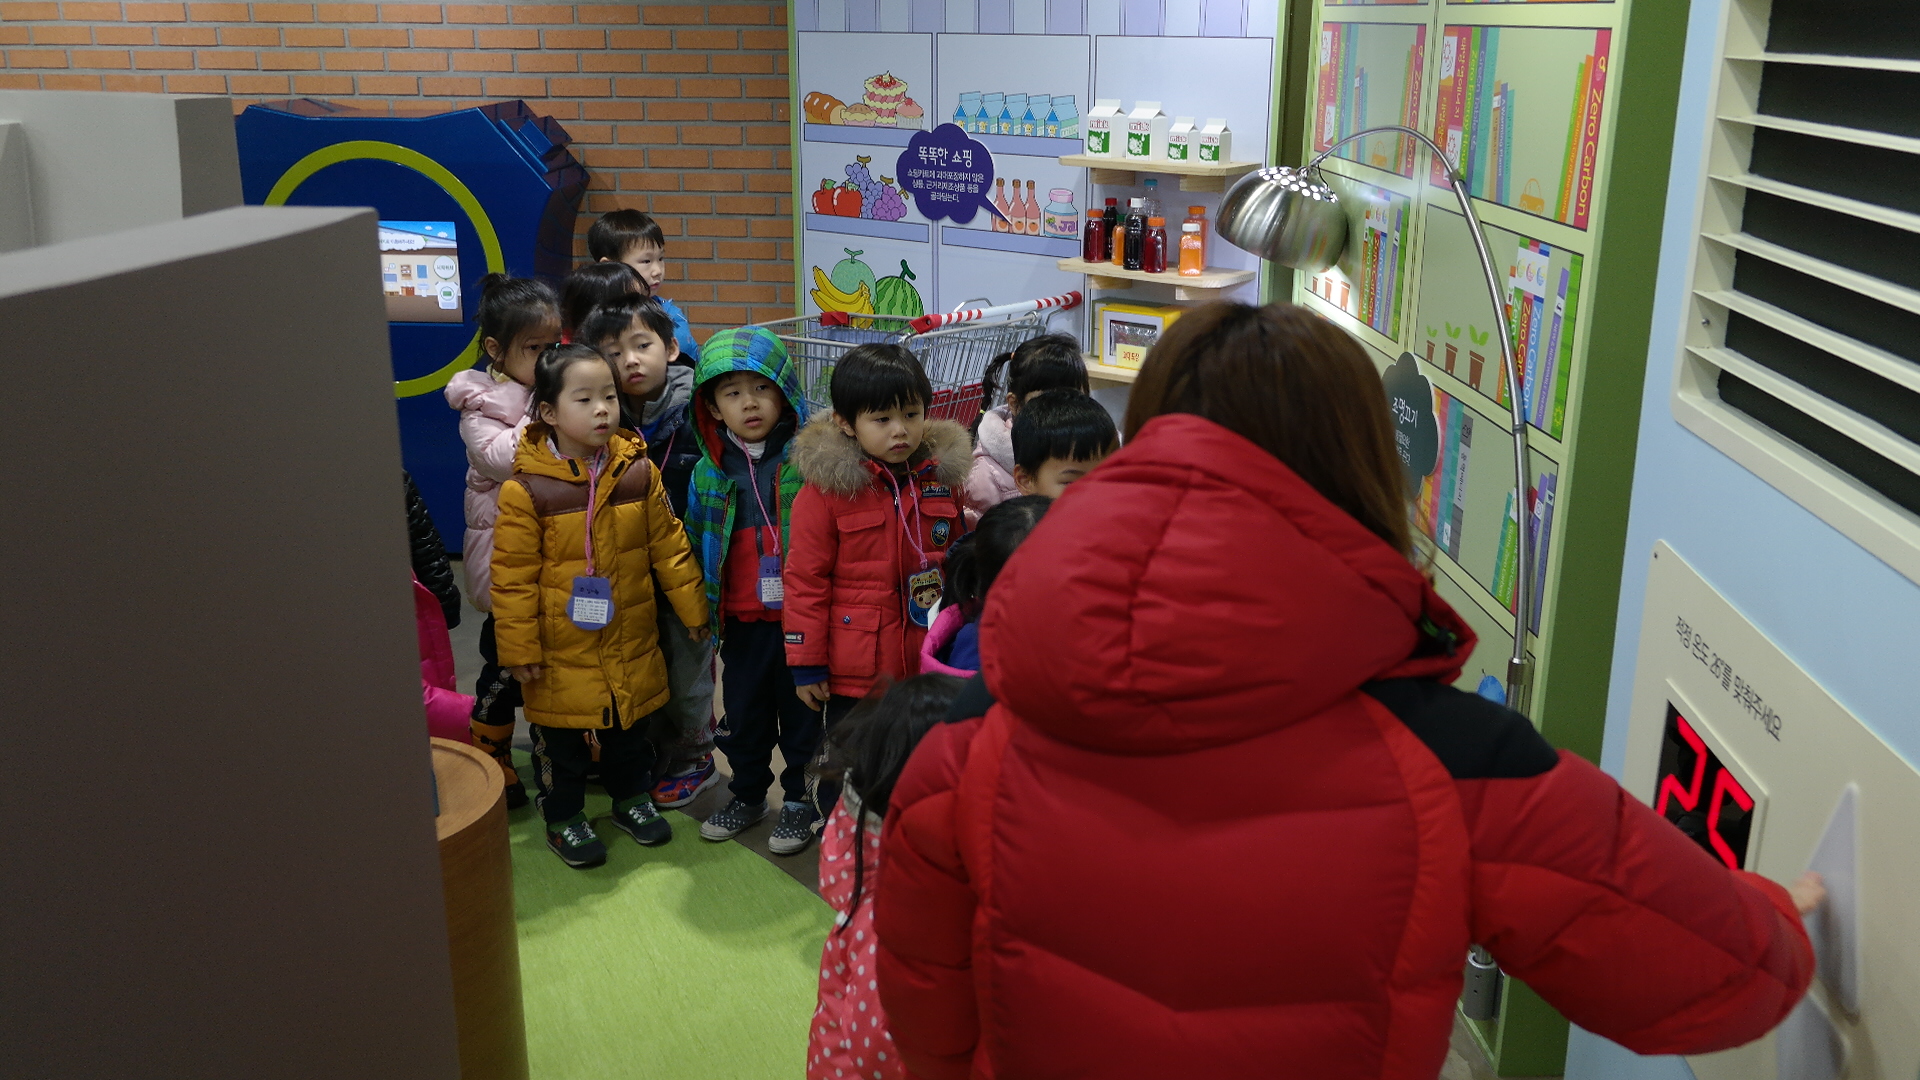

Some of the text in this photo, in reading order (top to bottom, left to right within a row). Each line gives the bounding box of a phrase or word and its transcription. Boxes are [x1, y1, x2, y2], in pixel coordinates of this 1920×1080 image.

[1454, 37, 1466, 118] 태양열에너지
[1476, 51, 1484, 92] Green
[1090, 120, 1108, 128] milk
[1129, 121, 1150, 131] milk
[1406, 70, 1422, 168] Zero Cabon
[1434, 98, 1446, 174] 태양광에지
[1460, 50, 1478, 175] Zero Energy House
[918, 146, 972, 168] 똑똑한 쇼핑
[1578, 88, 1602, 216] Zero Carbon
[1362, 267, 1370, 314] Carbon
[1368, 237, 1380, 318] Zero Carbon
[1374, 274, 1382, 320] Carbon
[1512, 298, 1520, 336] Zero
[1517, 302, 1530, 376] Zero Car
[1524, 306, 1541, 408] Zero Carbon
[1392, 397, 1418, 428] 조명끄기
[1676, 616, 1782, 742] 적정 온도 26°를 맞춰주세요
